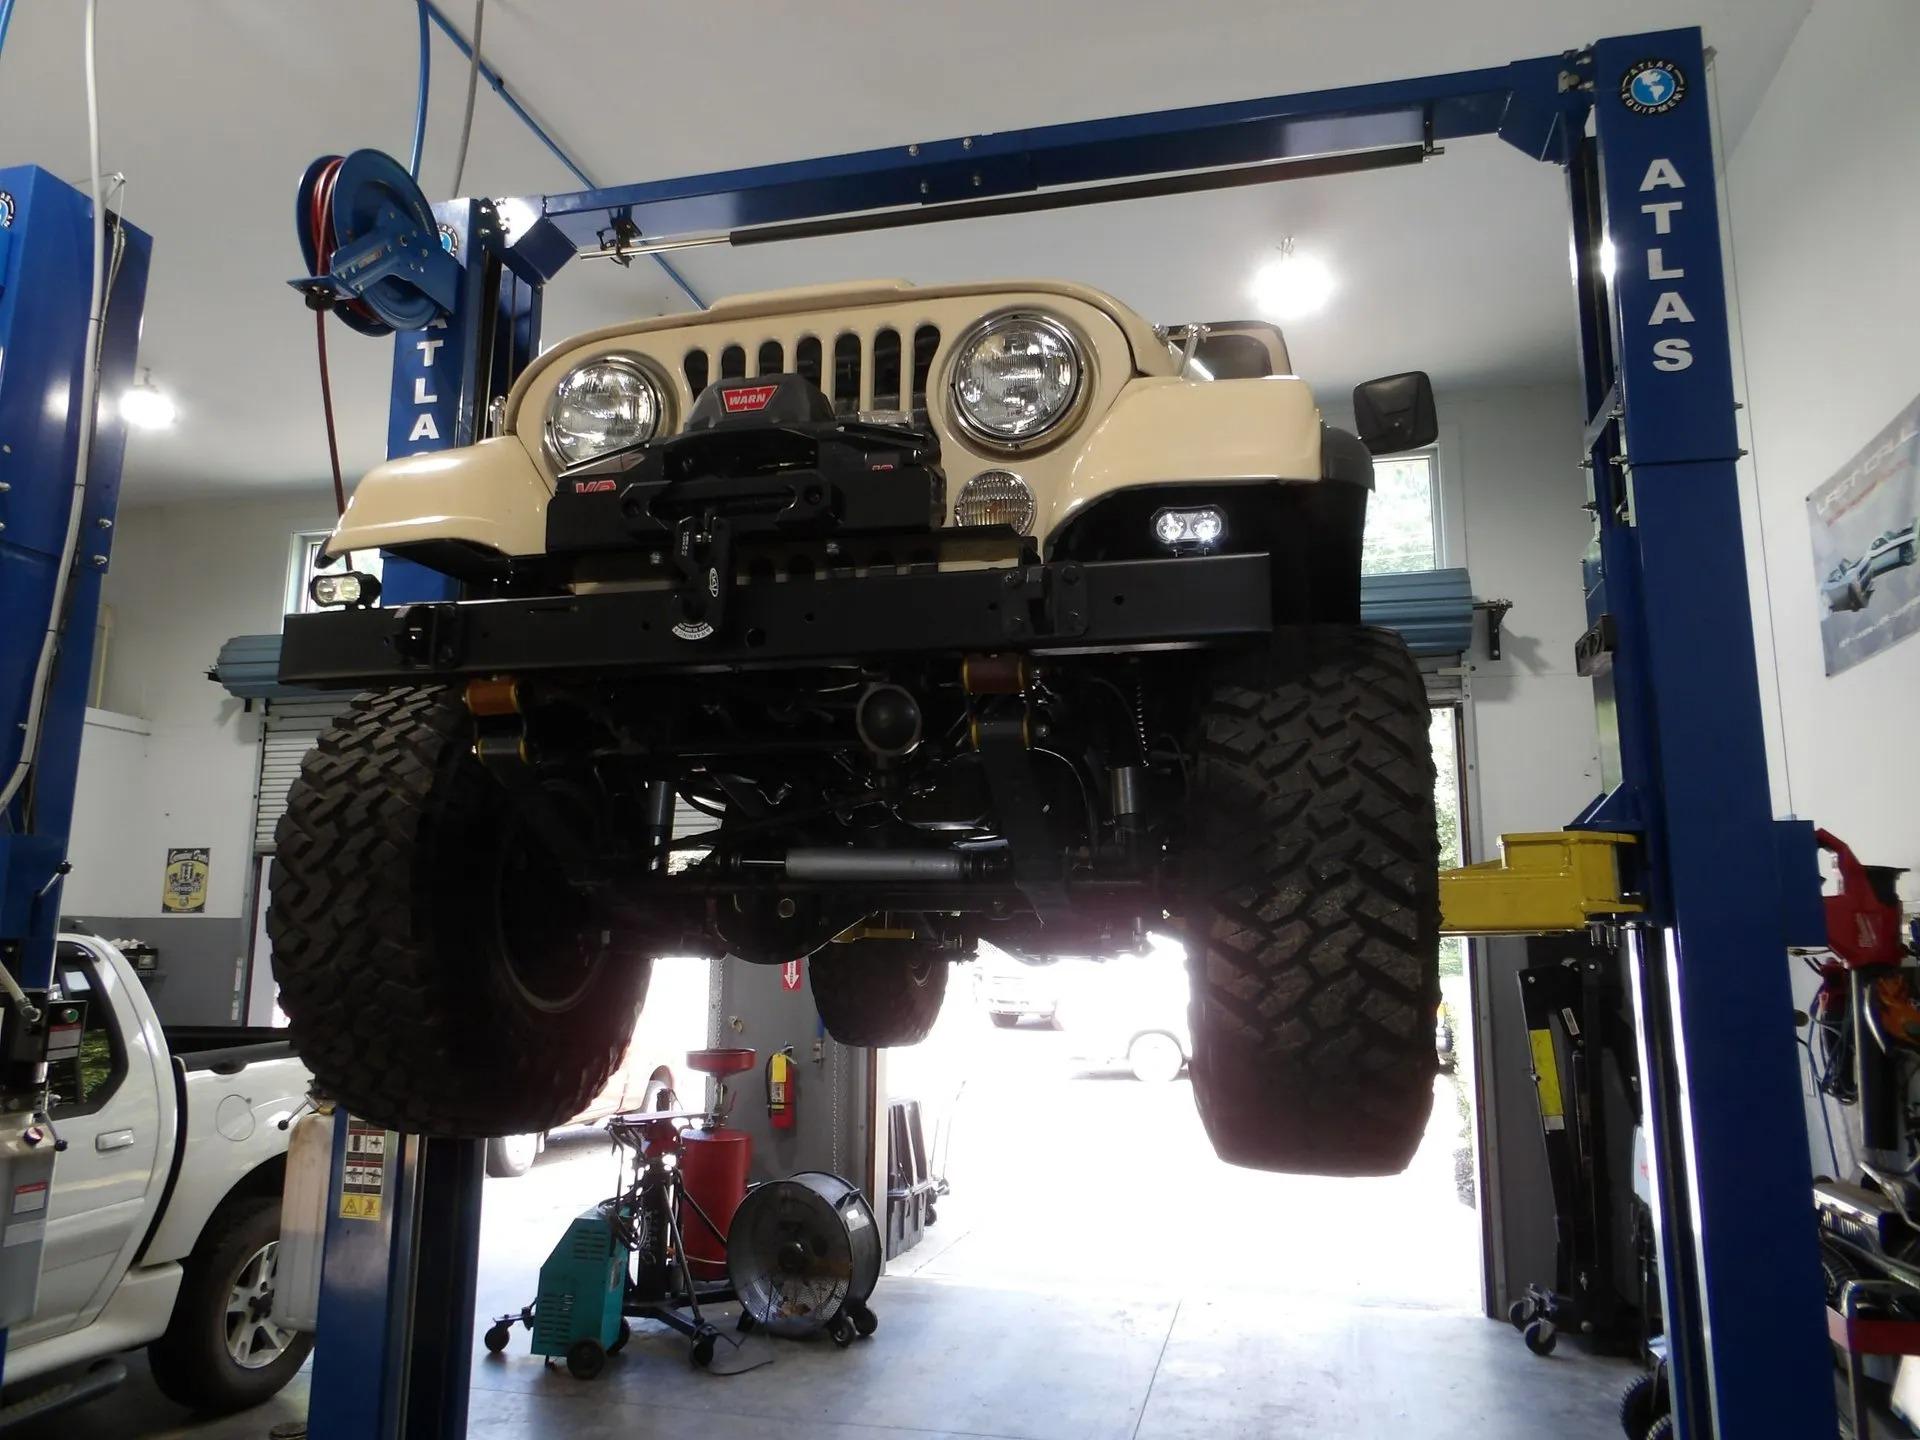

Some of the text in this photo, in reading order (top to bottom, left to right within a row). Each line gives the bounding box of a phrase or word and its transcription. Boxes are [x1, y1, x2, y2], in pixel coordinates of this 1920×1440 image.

[1630, 61, 1674, 75] ATLAS
[1622, 87, 1685, 114] EQUIPMENT
[1639, 158, 1696, 372] ATLAS
[409, 318, 447, 455] TLA
[728, 393, 767, 406] WARN
